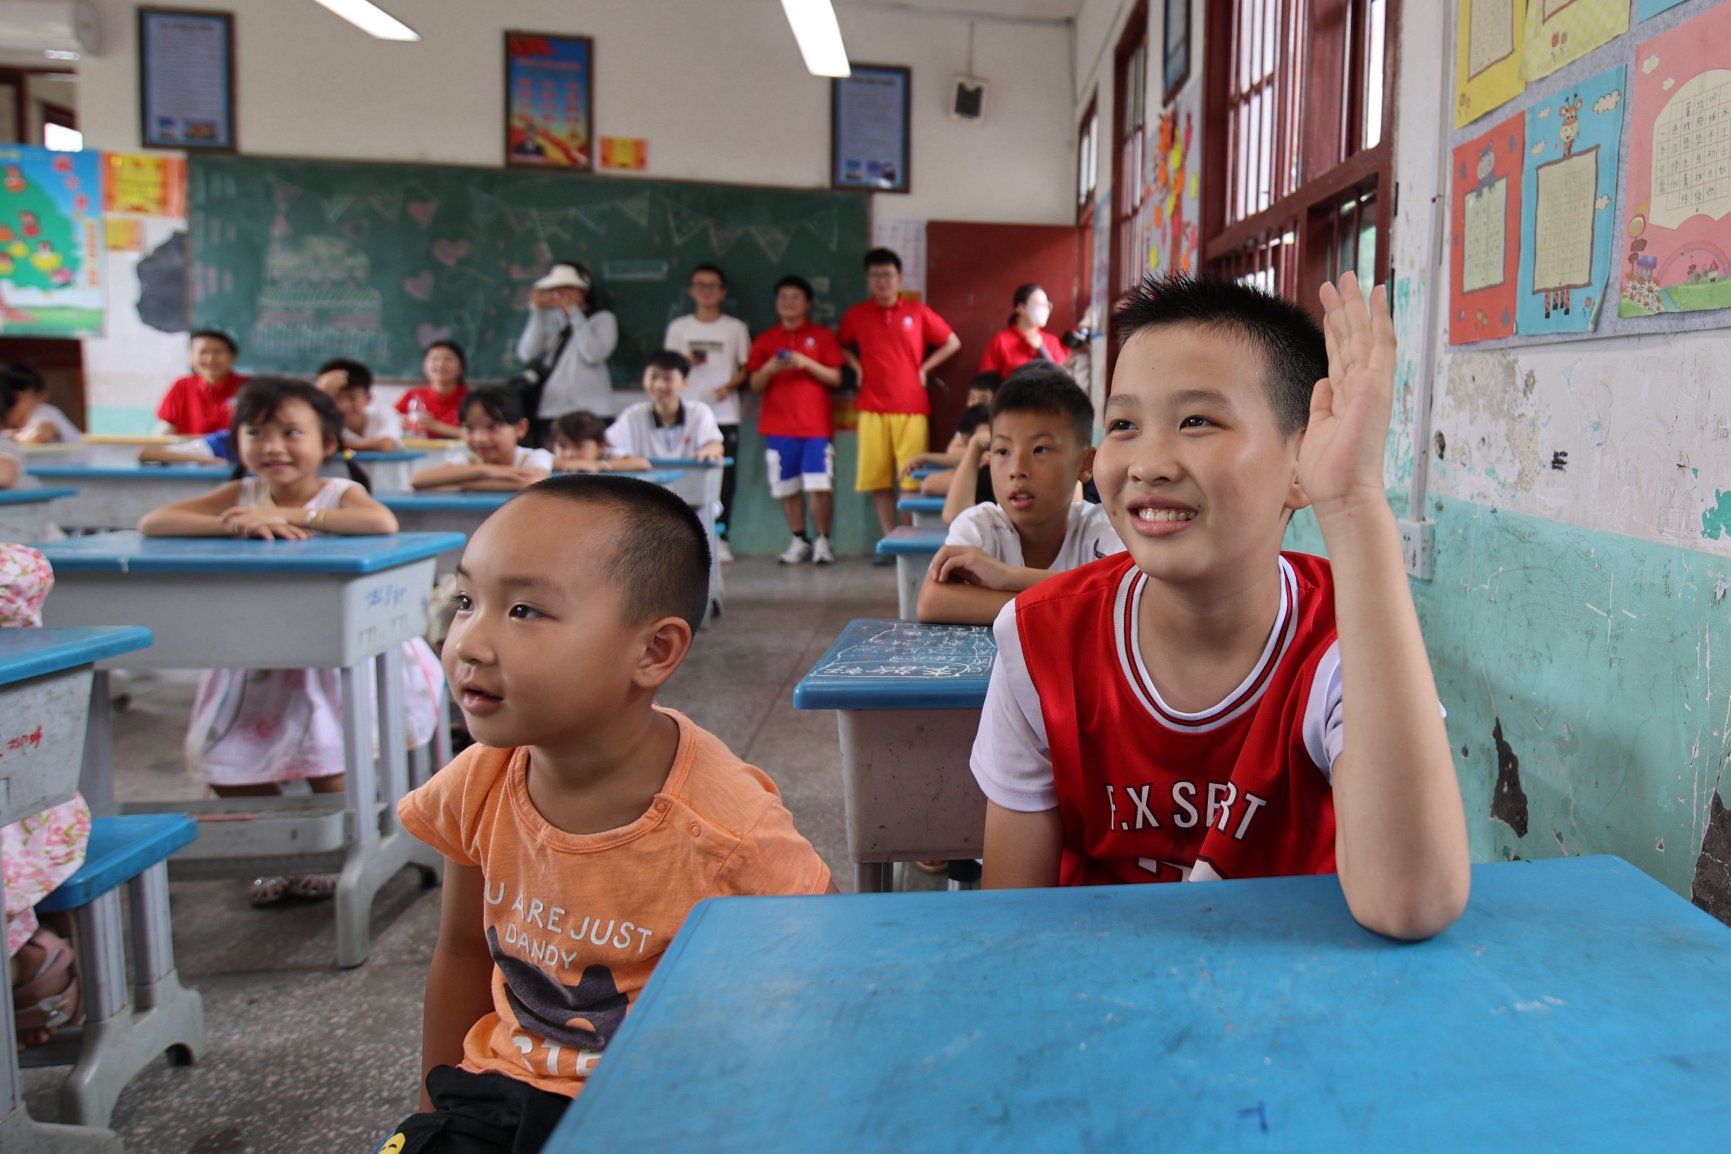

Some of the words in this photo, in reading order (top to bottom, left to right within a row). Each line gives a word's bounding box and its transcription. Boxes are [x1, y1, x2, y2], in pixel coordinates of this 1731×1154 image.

[485, 880, 505, 905] U
[511, 889, 566, 935] ARE
[569, 915, 653, 953] JUST
[504, 923, 577, 969] DANDY
